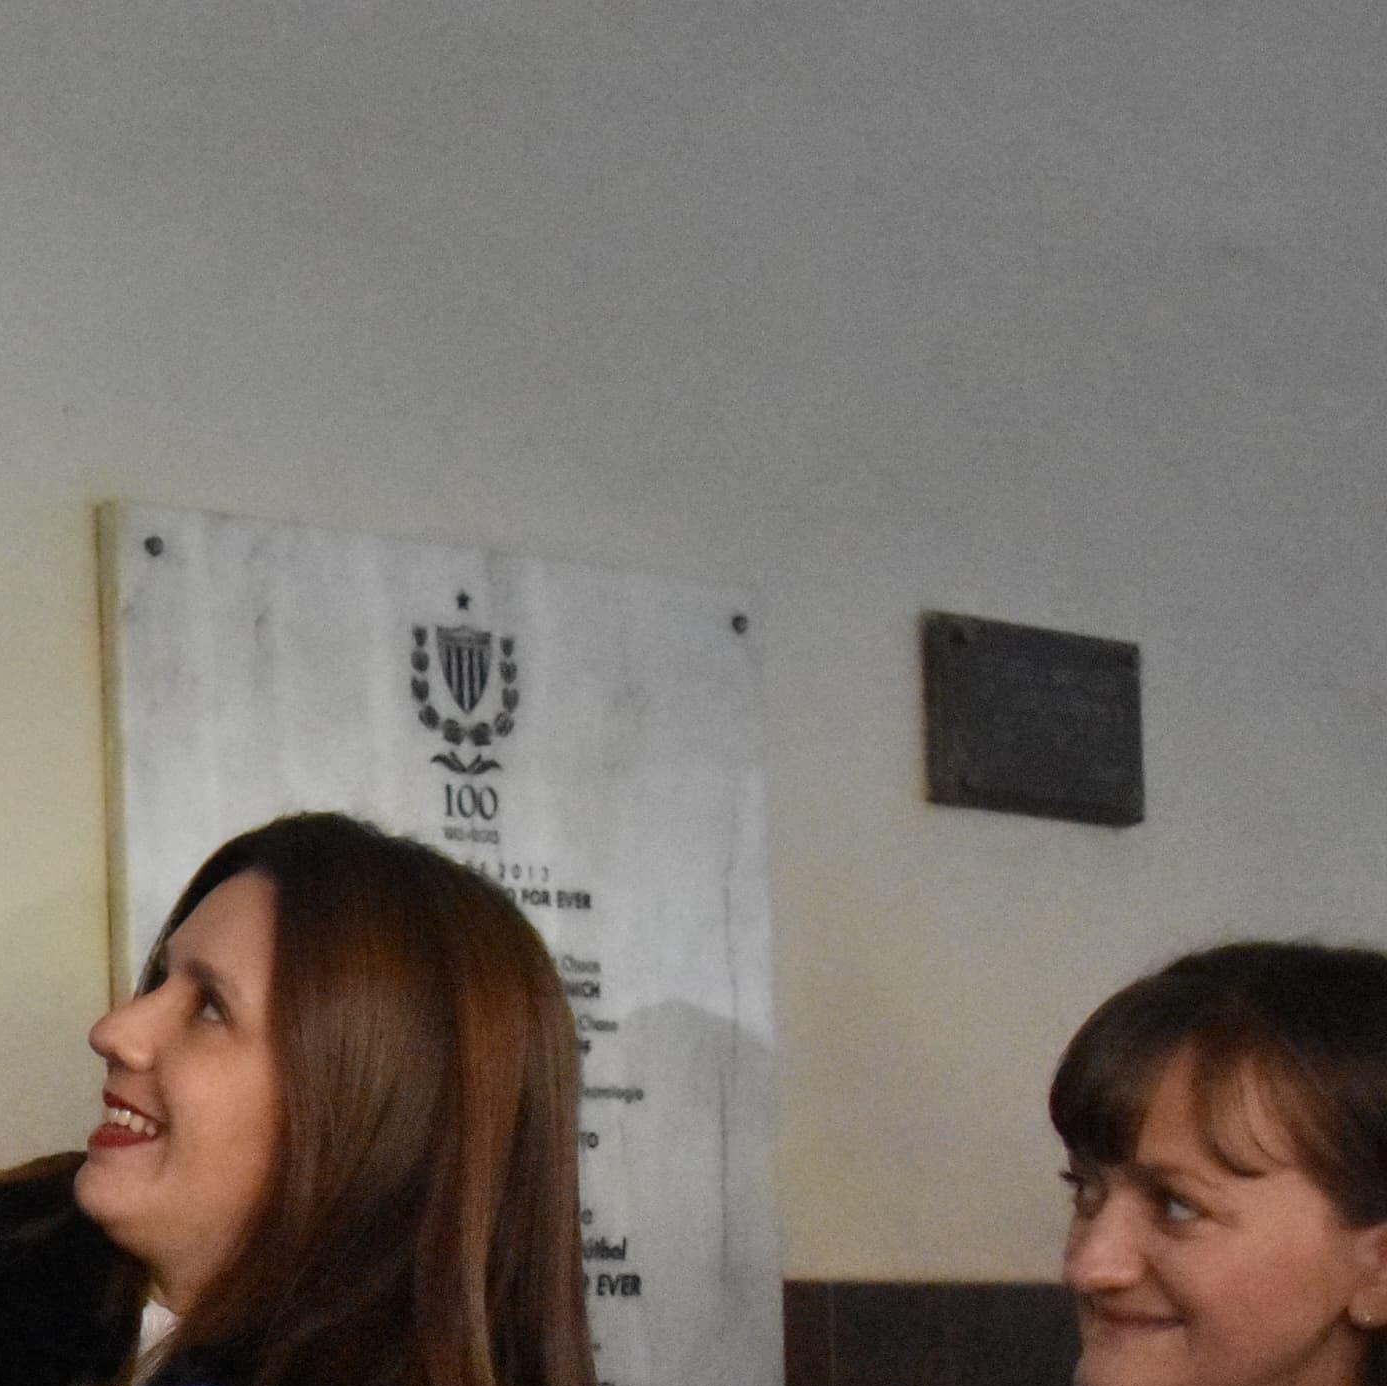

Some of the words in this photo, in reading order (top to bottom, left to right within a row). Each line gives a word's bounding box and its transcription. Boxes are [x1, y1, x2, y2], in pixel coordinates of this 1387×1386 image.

[443, 783, 499, 821] 100
[556, 890, 592, 911] EVER
[597, 1273, 642, 1297] EVER
